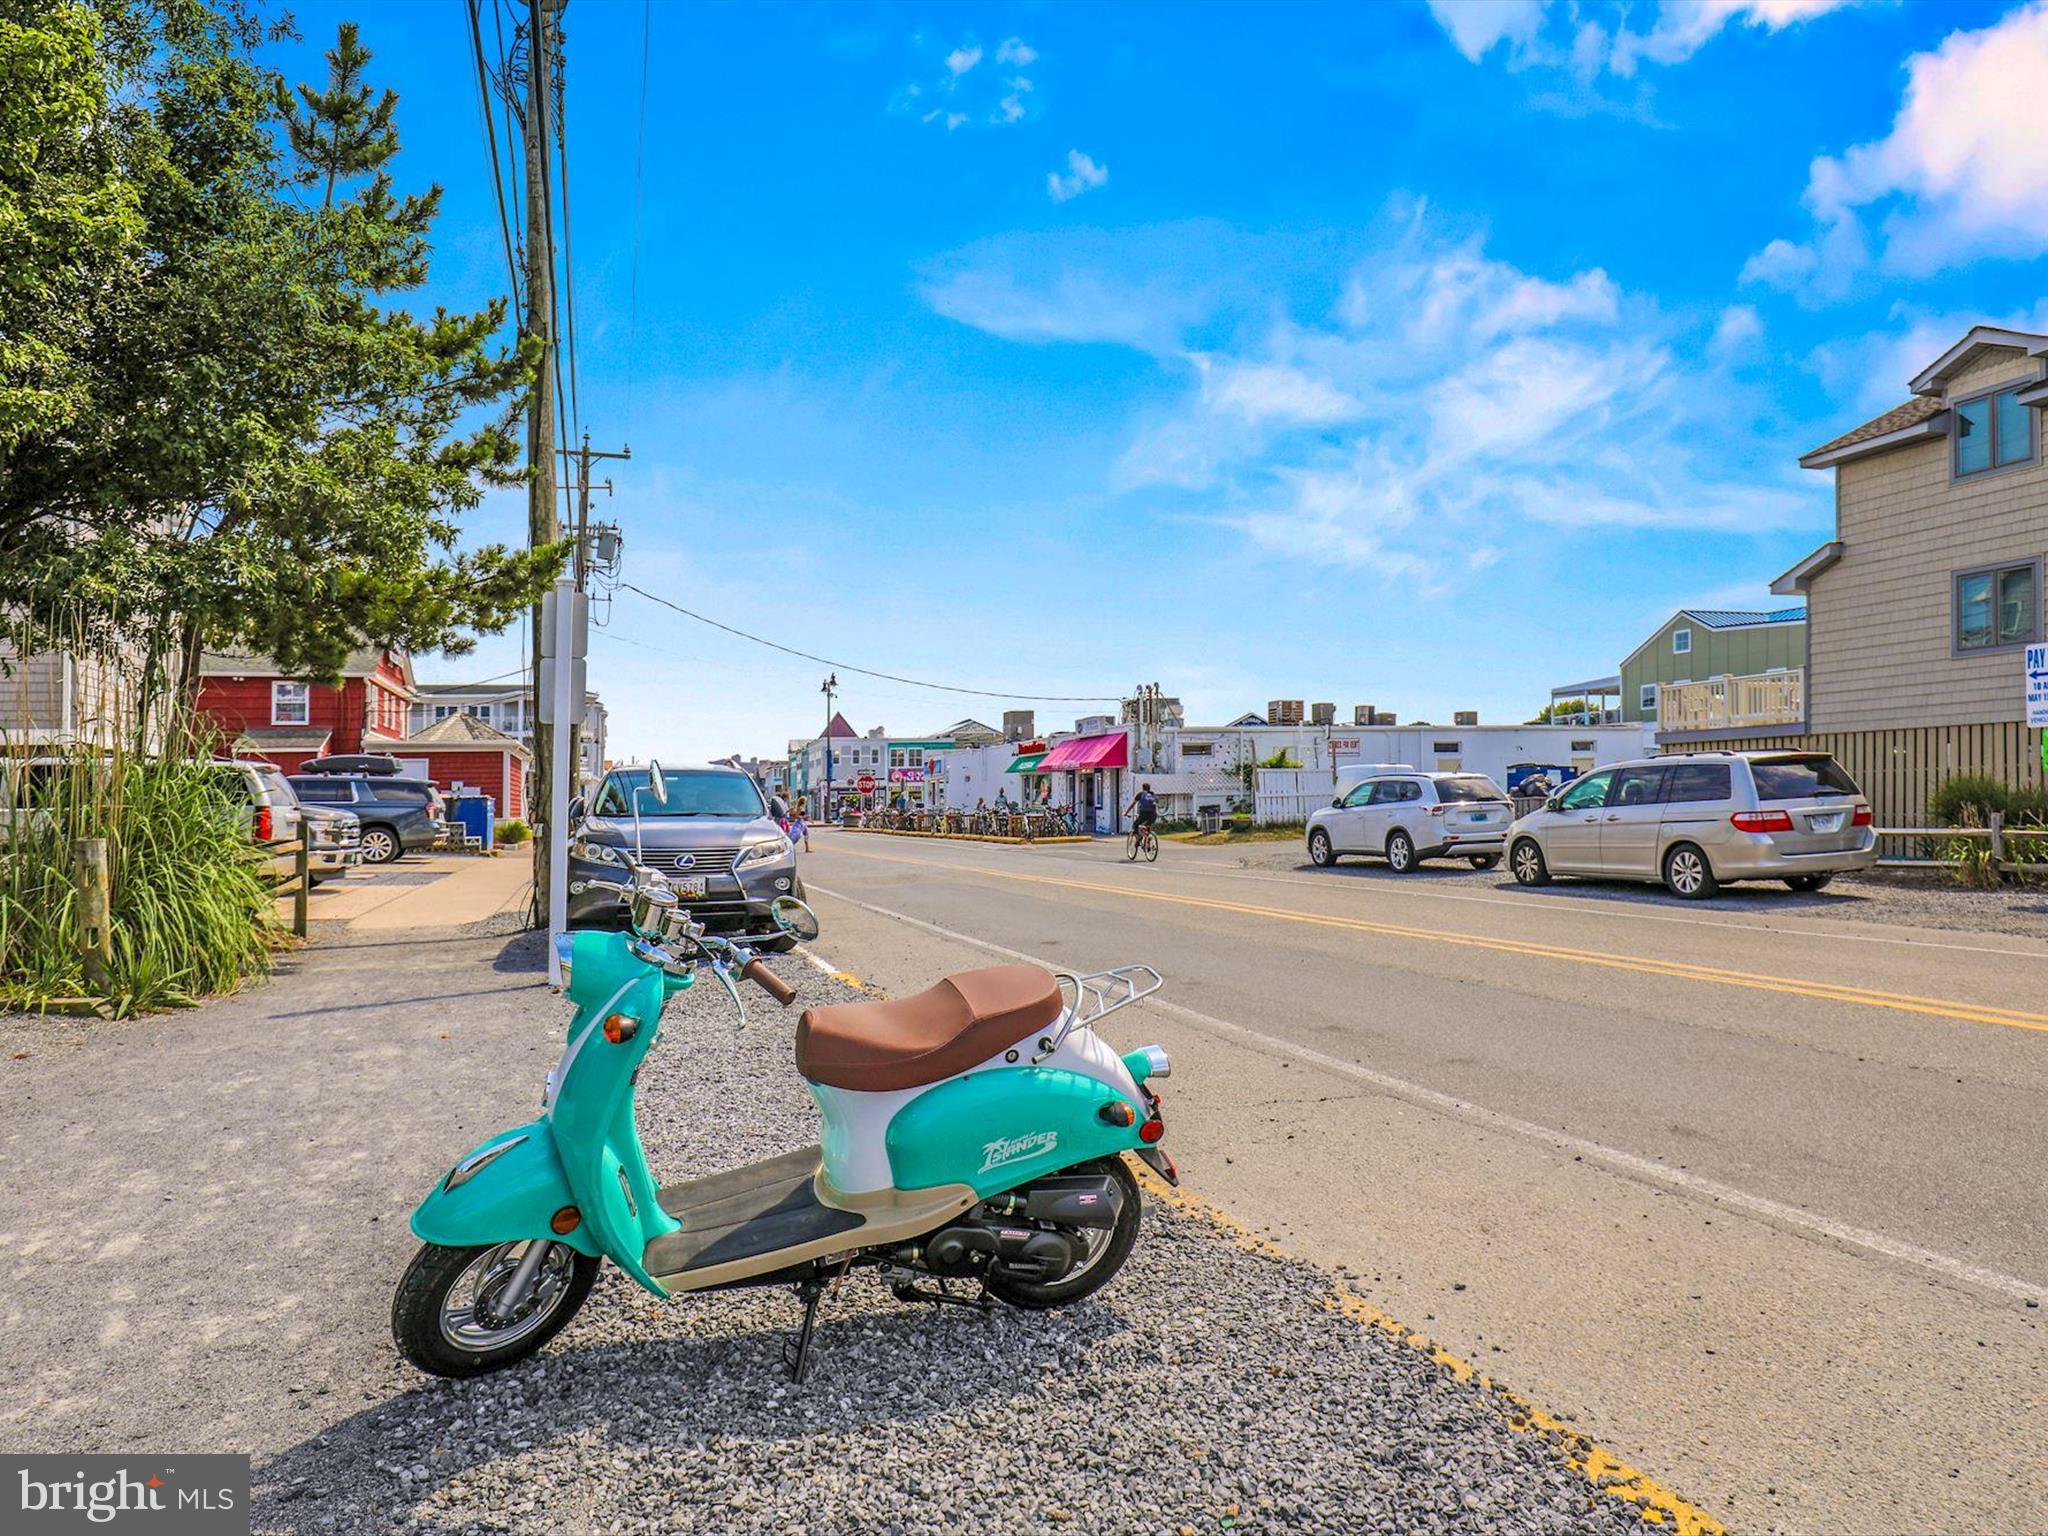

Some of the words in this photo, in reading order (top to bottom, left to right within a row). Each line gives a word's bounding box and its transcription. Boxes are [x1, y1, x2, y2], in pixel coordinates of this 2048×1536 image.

[2028, 648, 2045, 669] PAY
[2028, 694, 2041, 702] MAY
[858, 781, 875, 789] STOP
[980, 1131, 1057, 1171] ISLANDER
